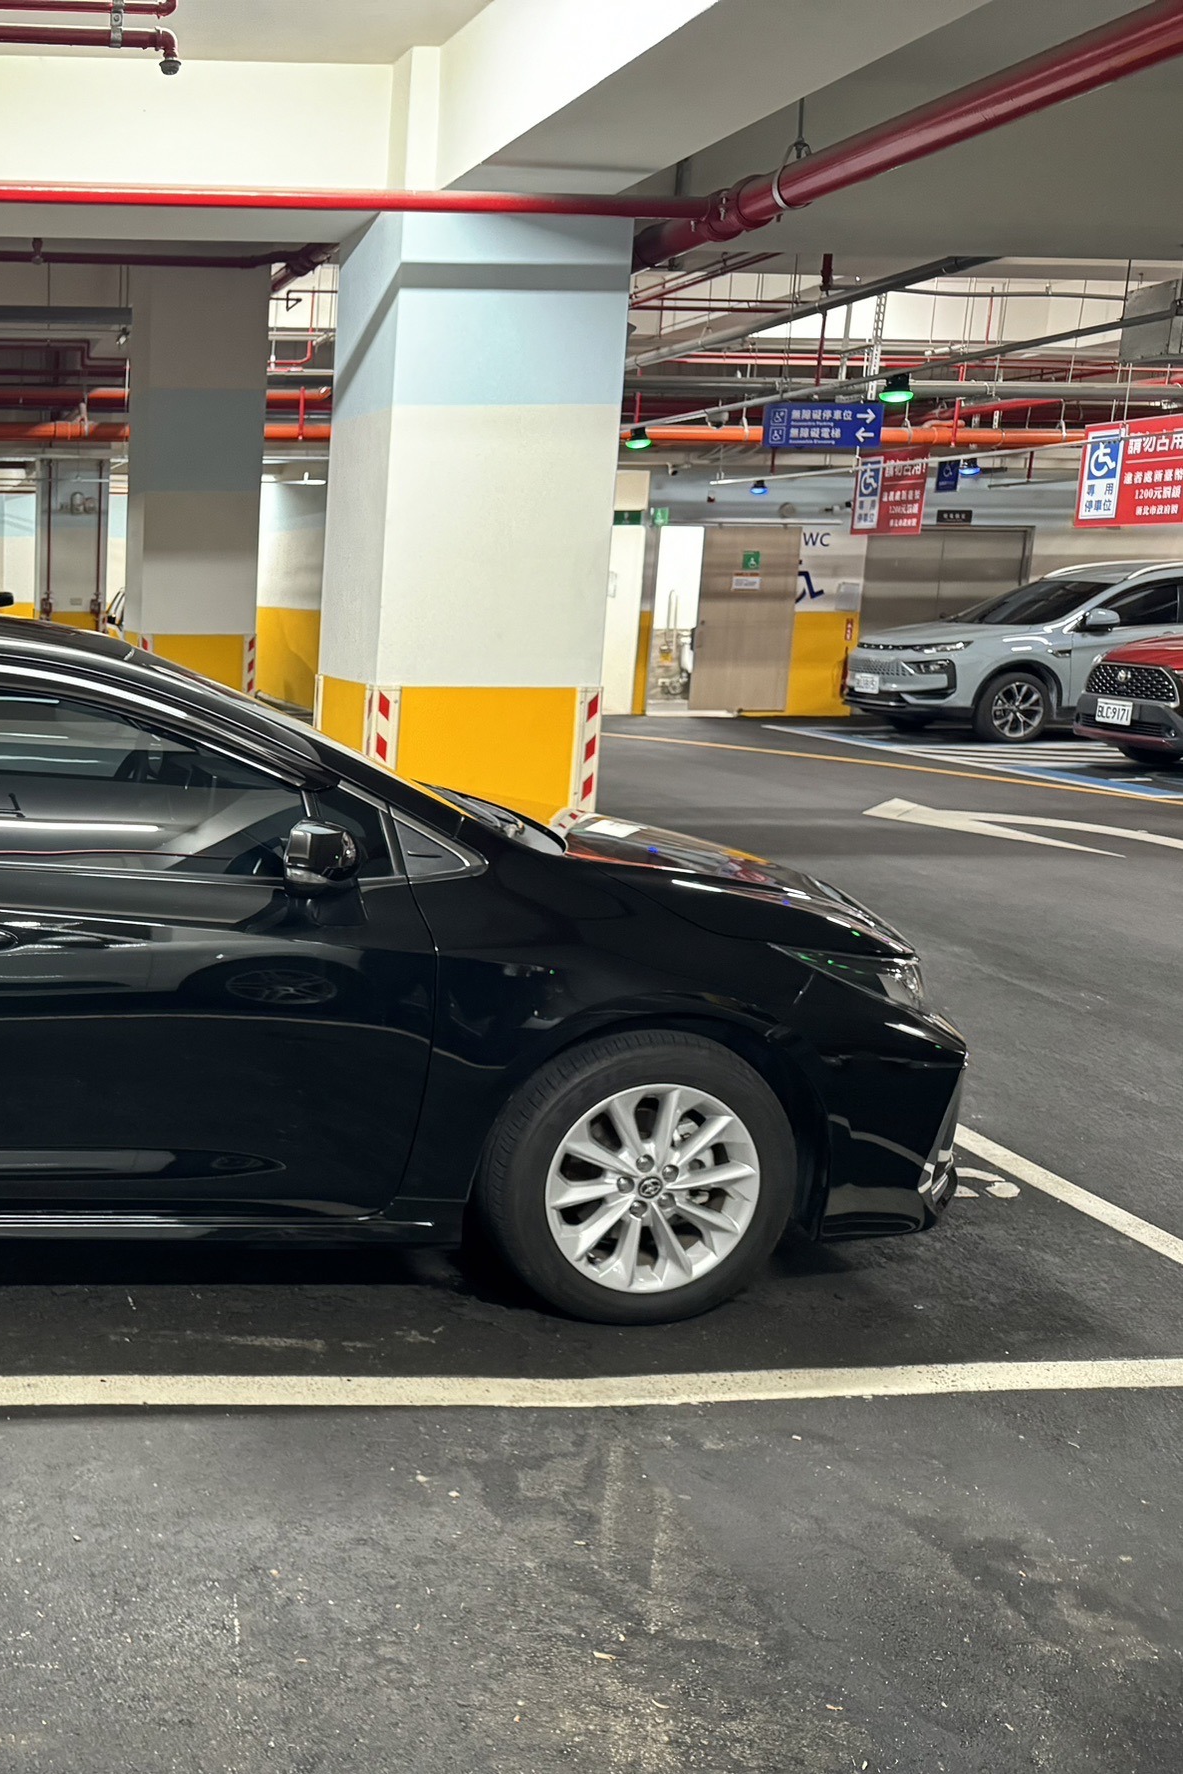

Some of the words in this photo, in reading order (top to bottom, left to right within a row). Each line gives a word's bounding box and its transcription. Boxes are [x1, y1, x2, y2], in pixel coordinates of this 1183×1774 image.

[790, 408, 853, 421] 無障礙停車位
[789, 427, 841, 439] 無障礙電梯
[803, 532, 832, 547] WC
